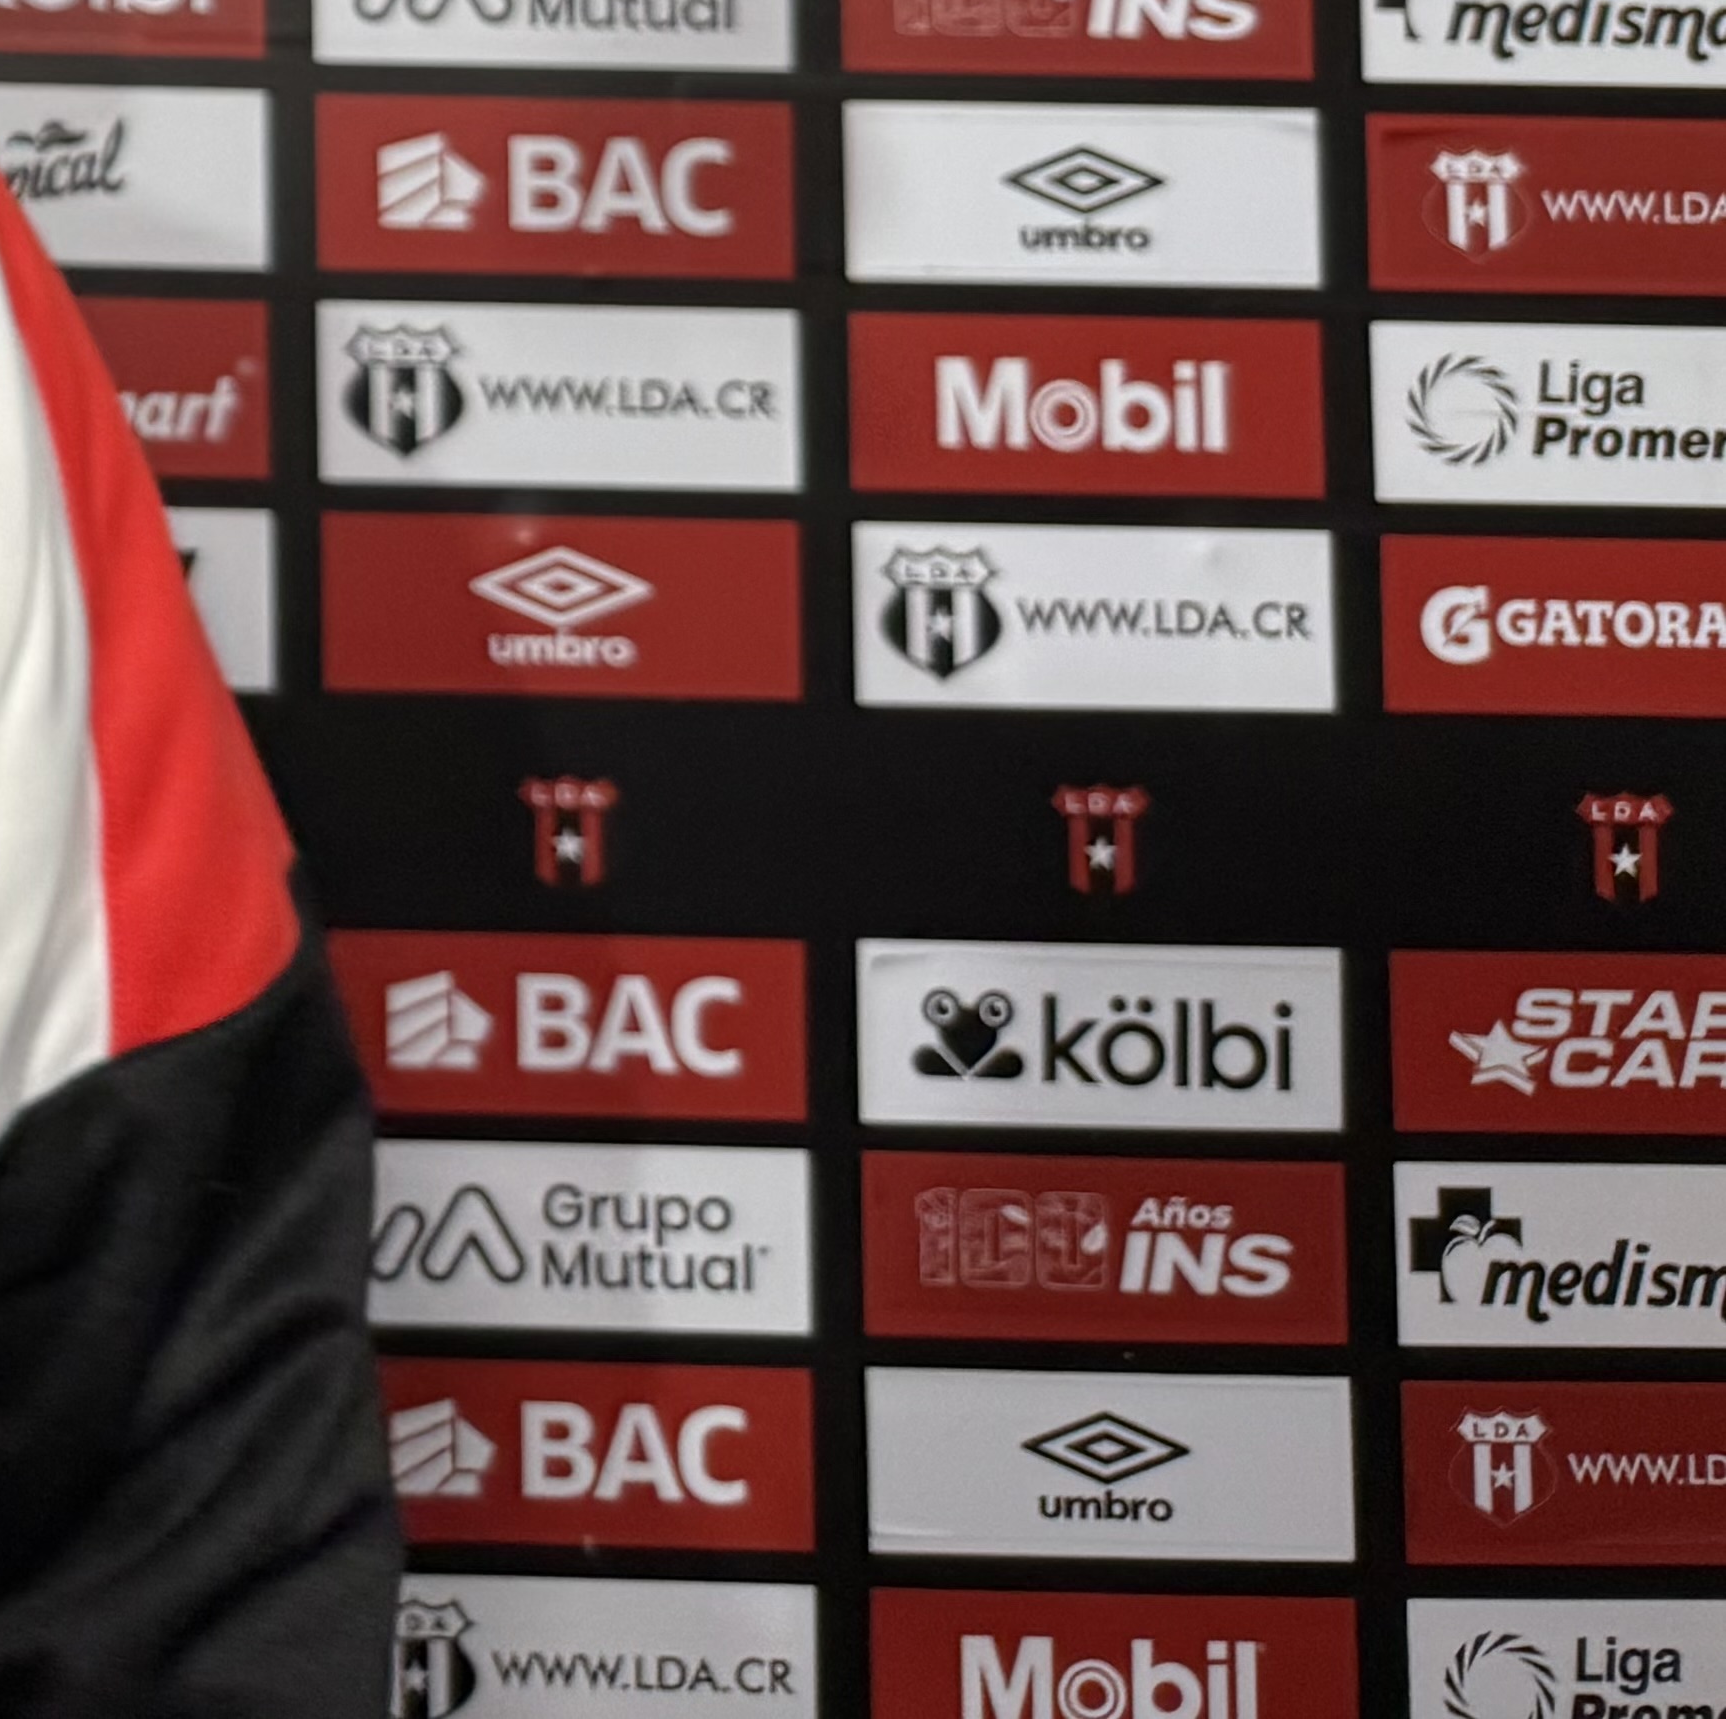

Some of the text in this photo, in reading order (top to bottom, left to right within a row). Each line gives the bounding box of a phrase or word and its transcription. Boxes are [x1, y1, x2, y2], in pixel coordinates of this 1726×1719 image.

[509, 136, 730, 235] BAC
[1020, 216, 1152, 252] umbro
[480, 377, 775, 419] WWW.LDA.CR
[937, 357, 1227, 452] Mobil
[1539, 361, 1644, 418] Liga
[490, 626, 635, 666] umbro
[1017, 599, 1311, 639] WWW.LDA.CR
[1592, 801, 1656, 820] LDA
[518, 974, 741, 1076] BAC
[1043, 994, 1292, 1091] kölbi
[541, 1182, 733, 1248] Grupo
[1132, 1197, 1232, 1229] Años
[541, 1241, 754, 1292] Mutual
[1120, 1232, 1292, 1296] INS
[523, 1402, 748, 1505] BAC
[1471, 1419, 1531, 1440] LDA
[1039, 1490, 1174, 1522] umbro
[491, 1651, 794, 1695] WWW.LDA.CR
[961, 1635, 1257, 1719] Mobil
[1576, 1637, 1681, 1696] Liga
